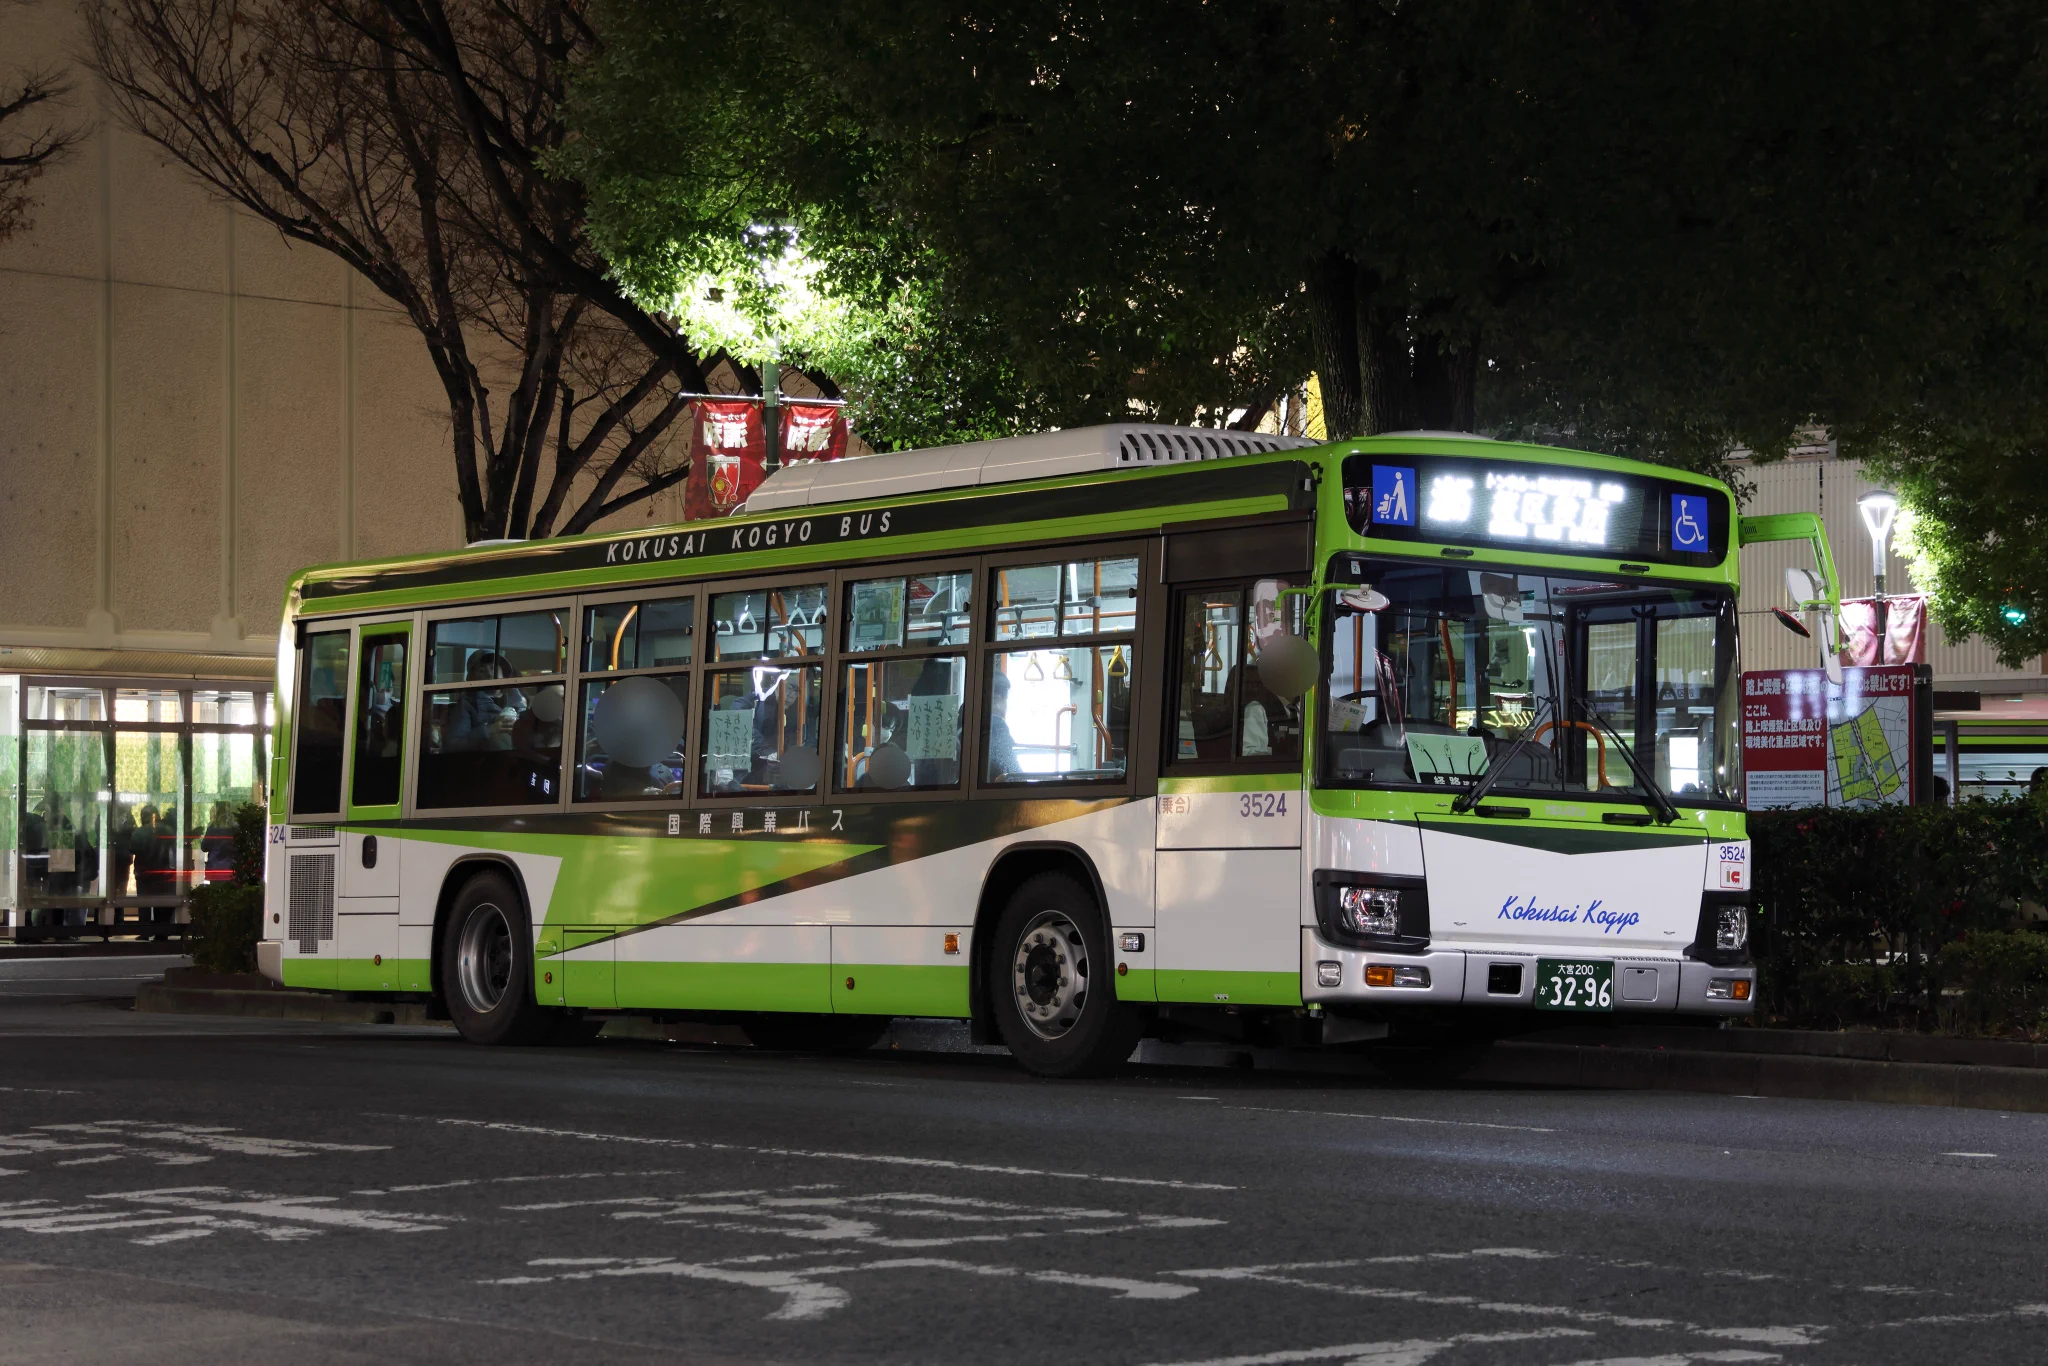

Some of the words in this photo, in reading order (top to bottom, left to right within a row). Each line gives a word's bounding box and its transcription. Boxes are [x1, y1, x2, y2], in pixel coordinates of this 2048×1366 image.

[606, 533, 706, 563] KOKUSAI
[731, 520, 812, 549] KOGYO
[840, 511, 891, 537] BUS
[1745, 704, 1771, 717] ここは、
[1745, 734, 1825, 749] 環境美化重点区域です。
[1157, 796, 1191, 815] (乗合)
[1240, 792, 1288, 818] 3524
[1545, 804, 1586, 817] ISUZU
[668, 809, 844, 835] 国際興業バス
[1719, 845, 1746, 862] 3524
[1497, 895, 1580, 924] Kokusai
[1582, 899, 1640, 935] Kogyo
[1539, 984, 1548, 996] か
[1549, 975, 1611, 1007] 32-96
